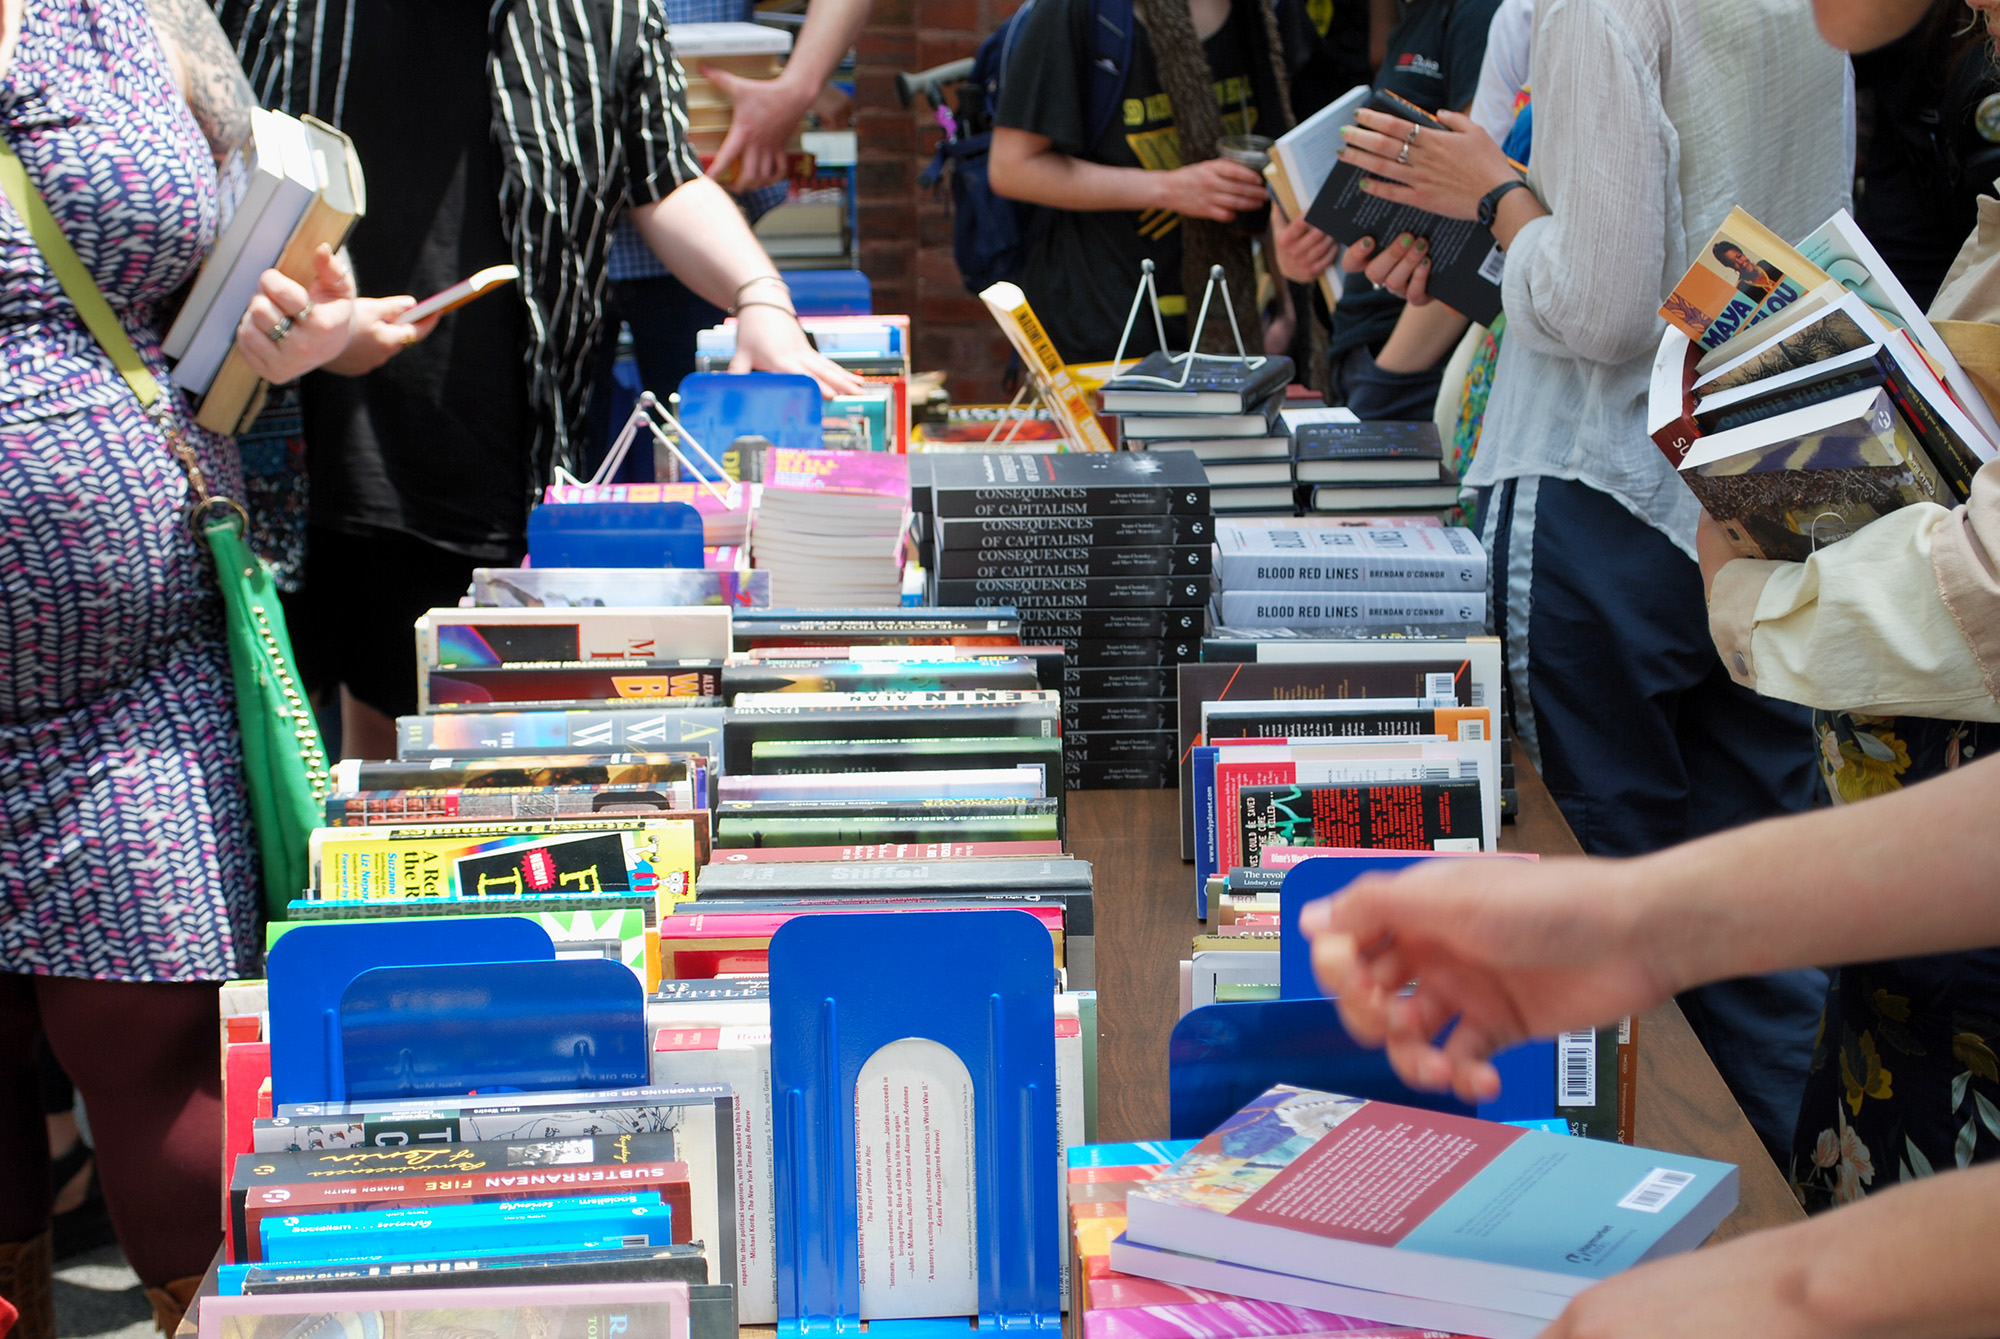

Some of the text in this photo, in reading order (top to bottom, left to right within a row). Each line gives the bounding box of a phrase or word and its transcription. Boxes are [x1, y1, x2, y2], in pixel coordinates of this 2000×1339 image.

[1702, 299, 1754, 349] MAYA
[976, 488, 1087, 502] CONSEQUENCES
[975, 503, 1088, 516] OF CAPITALISM
[982, 518, 1093, 533] CONSEQUENCES
[982, 534, 1094, 547] OF CAPITALISM
[978, 548, 1089, 563] CONSEQUENCES
[977, 565, 1090, 577] OF CAPITALISM
[1257, 567, 1445, 579] BLOOD RED LINES BRENDAN O'CONNOR
[976, 579, 1087, 594] CONSEQUENCES
[975, 595, 1088, 607] OF CAPITALISM
[1257, 605, 1445, 618] BLOOD RED LINES BRENDAN O'CONNOR
[925, 691, 1047, 701] LENIN
[1246, 796, 1255, 817] SAVED
[1206, 786, 1215, 863] www.lonelyplanet.com
[1248, 831, 1257, 852] COULD
[361, 853, 371, 868] Liz
[404, 851, 419, 880] the
[1271, 854, 1291, 863] Dime's
[341, 853, 350, 885] Foreword
[387, 852, 398, 895] Suzanne
[529, 851, 550, 888] NEW!
[831, 866, 930, 883] Stiffed
[1243, 871, 1260, 879] The
[1243, 880, 1268, 888] Lindsey
[641, 1087, 696, 1096] WORKING
[699, 1085, 724, 1093] LIVE
[319, 1149, 451, 1165] Lenin
[736, 1159, 743, 1167] be
[306, 1161, 487, 1178] Reminiscences
[934, 1156, 942, 1180] (Starred
[323, 1168, 665, 1195] SUBTERRANEAN FIRE SHARON SMITH
[579, 1195, 637, 1206] Socialism
[737, 1181, 745, 1210] superiors,
[866, 1196, 874, 1211] Boys
[739, 1212, 747, 1237] political
[276, 1274, 314, 1282] TONY
